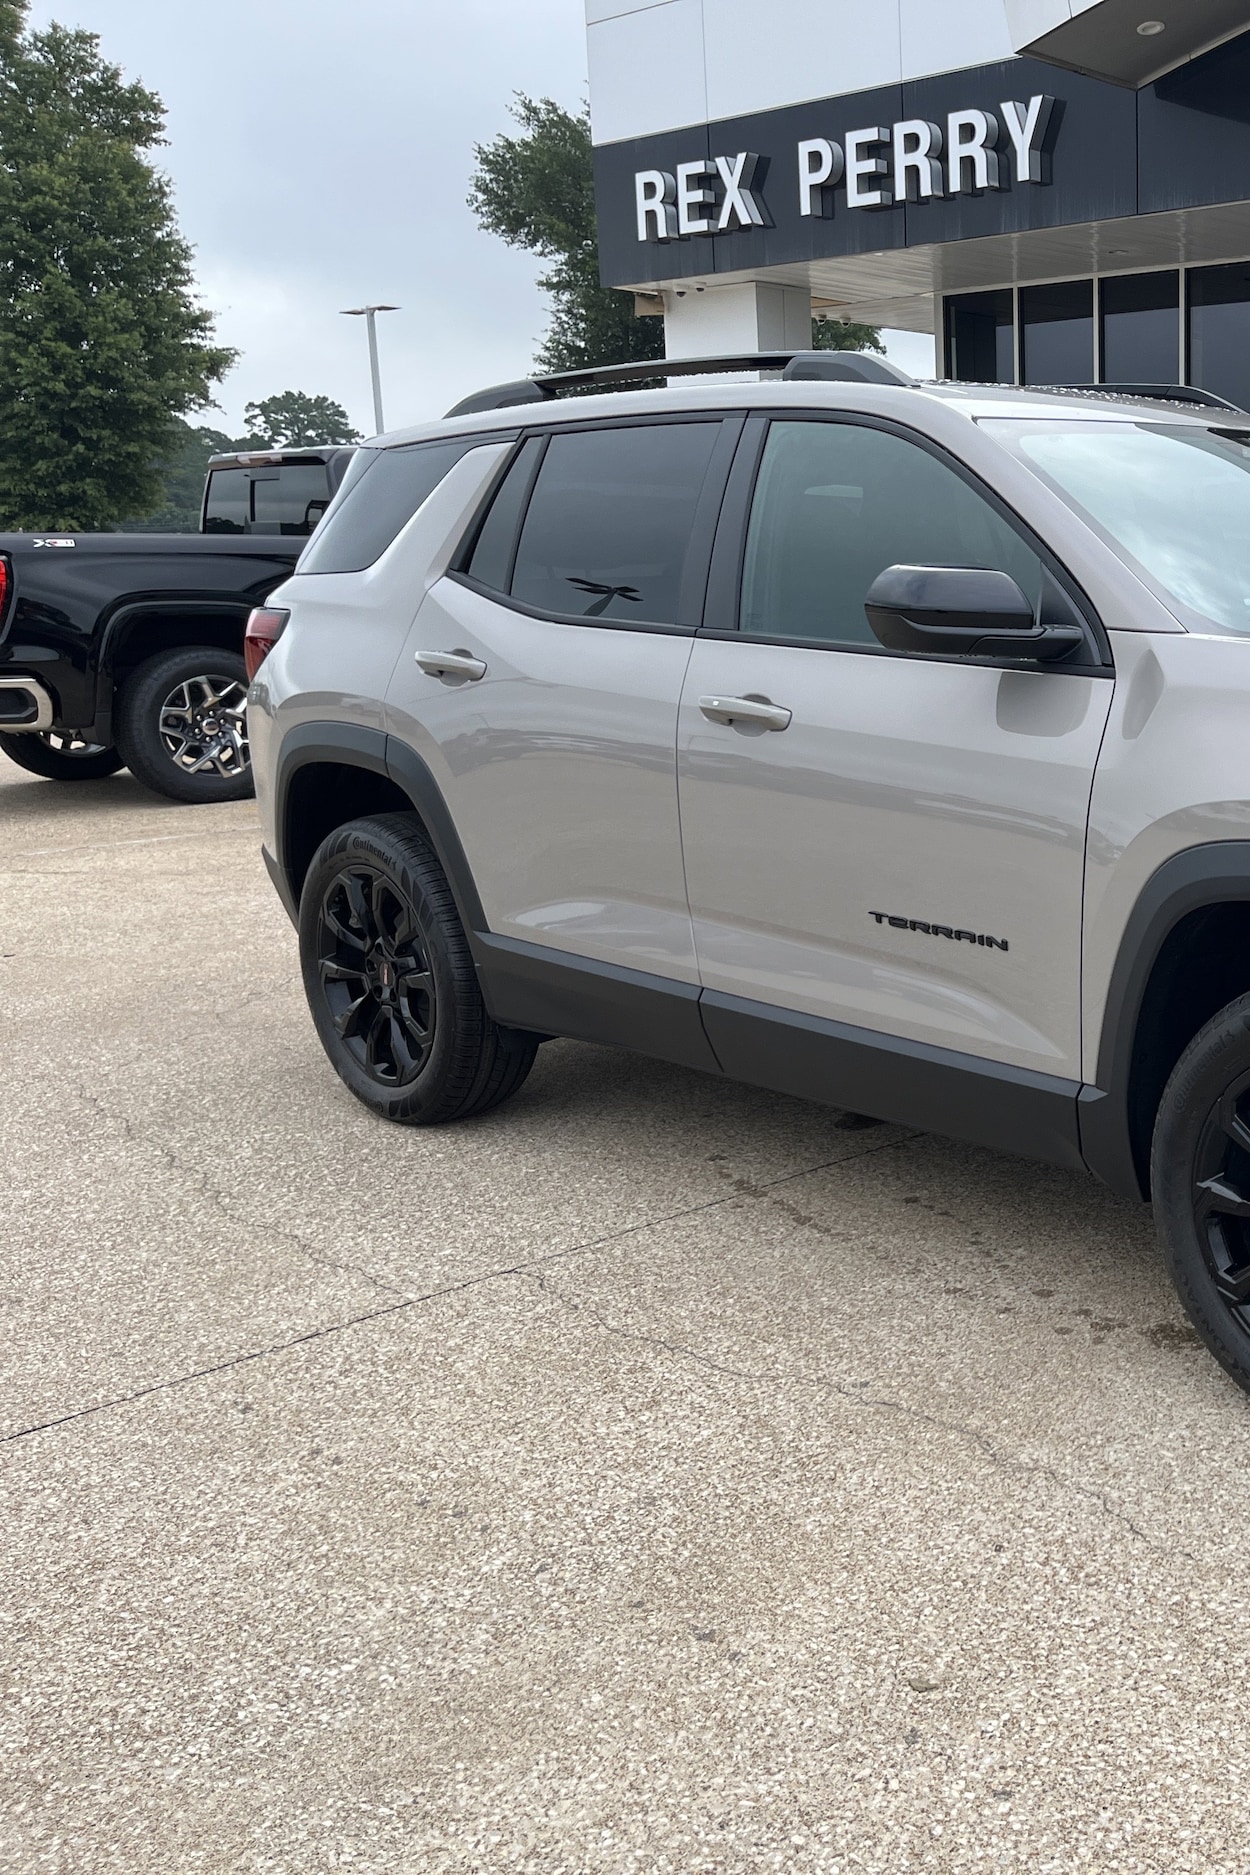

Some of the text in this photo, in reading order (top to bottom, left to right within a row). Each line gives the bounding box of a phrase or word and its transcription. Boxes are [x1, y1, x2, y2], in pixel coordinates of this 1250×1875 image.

[635, 93, 1056, 242] REX PERRY
[352, 836, 392, 867] Continental
[868, 910, 1009, 951] TERRAIN
